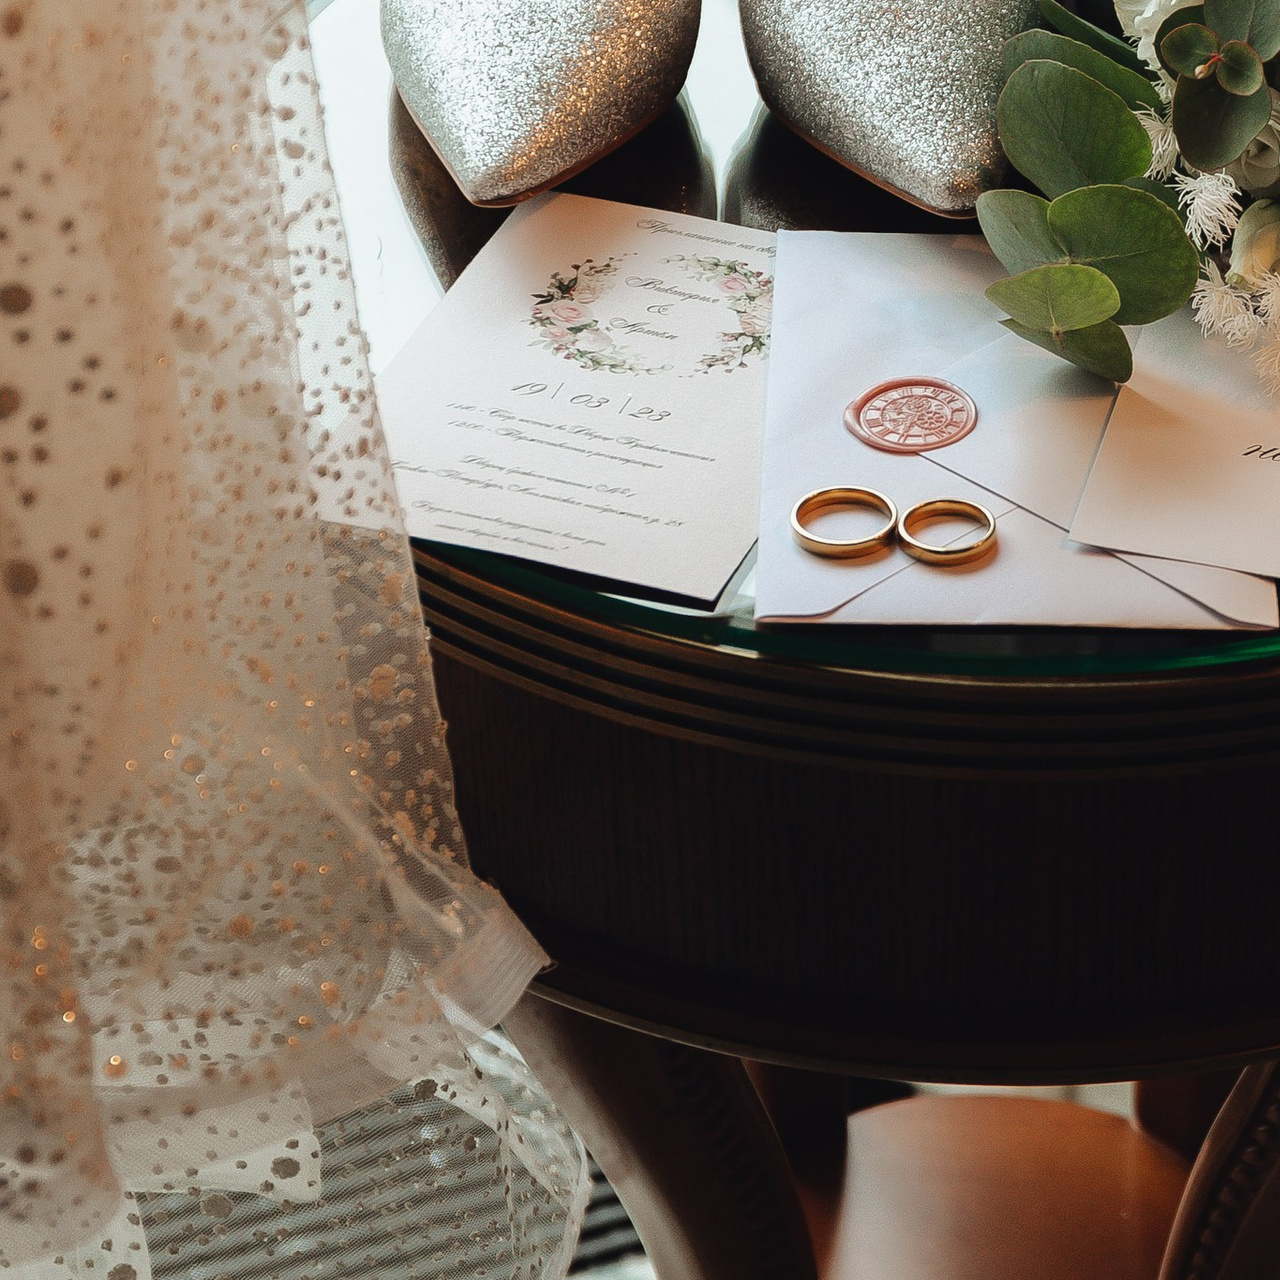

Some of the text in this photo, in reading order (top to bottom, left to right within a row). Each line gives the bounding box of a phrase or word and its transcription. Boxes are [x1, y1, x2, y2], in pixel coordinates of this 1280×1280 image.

[624, 276, 720, 303] Виктория
[646, 304, 674, 316] &
[511, 382, 548, 396] 19
[569, 394, 610, 408] 03
[628, 407, 671, 421] 23
